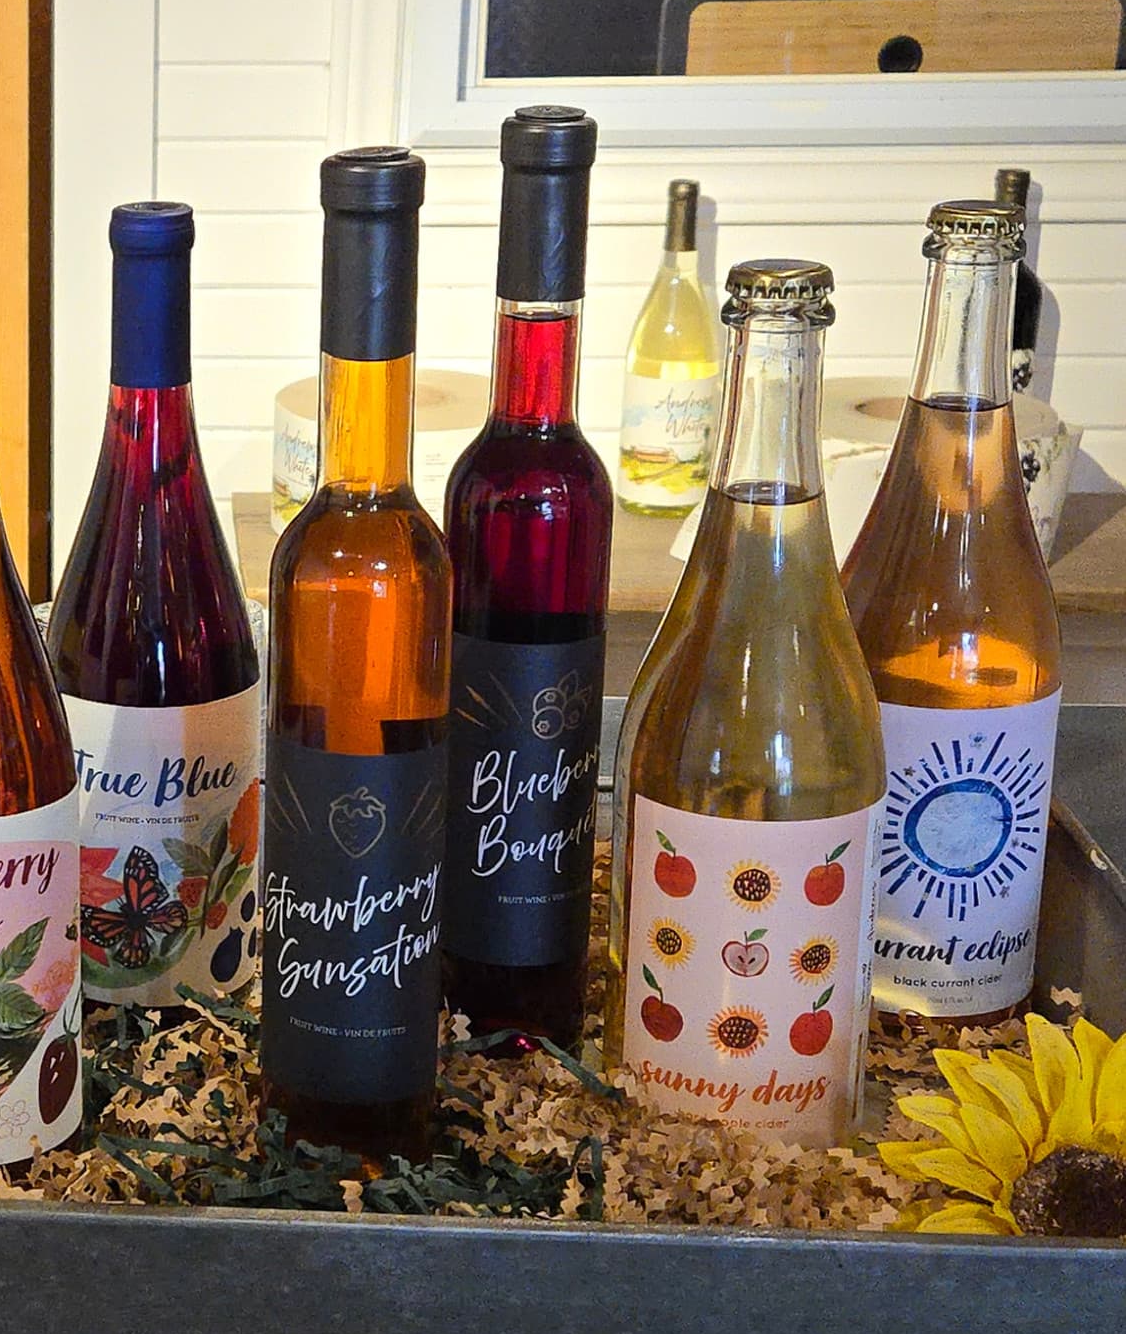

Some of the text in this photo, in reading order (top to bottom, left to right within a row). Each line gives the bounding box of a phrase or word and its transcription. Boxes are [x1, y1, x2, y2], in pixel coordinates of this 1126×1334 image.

[74, 748, 237, 808] True Blue
[466, 742, 601, 814] Blueberr
[145, 816, 161, 825] VIN
[264, 861, 442, 939] Strawberry
[498, 895, 523, 905] FRUIT
[524, 896, 548, 906] WINE
[278, 921, 441, 998] Sunsation
[874, 928, 1032, 966] urrant eclipse
[893, 973, 1003, 989] black currant cider
[289, 1016, 407, 1038] FRUIT WINE VIN DE FRUITS
[641, 1059, 832, 1114] sunny days
[755, 1118, 790, 1130] cider
